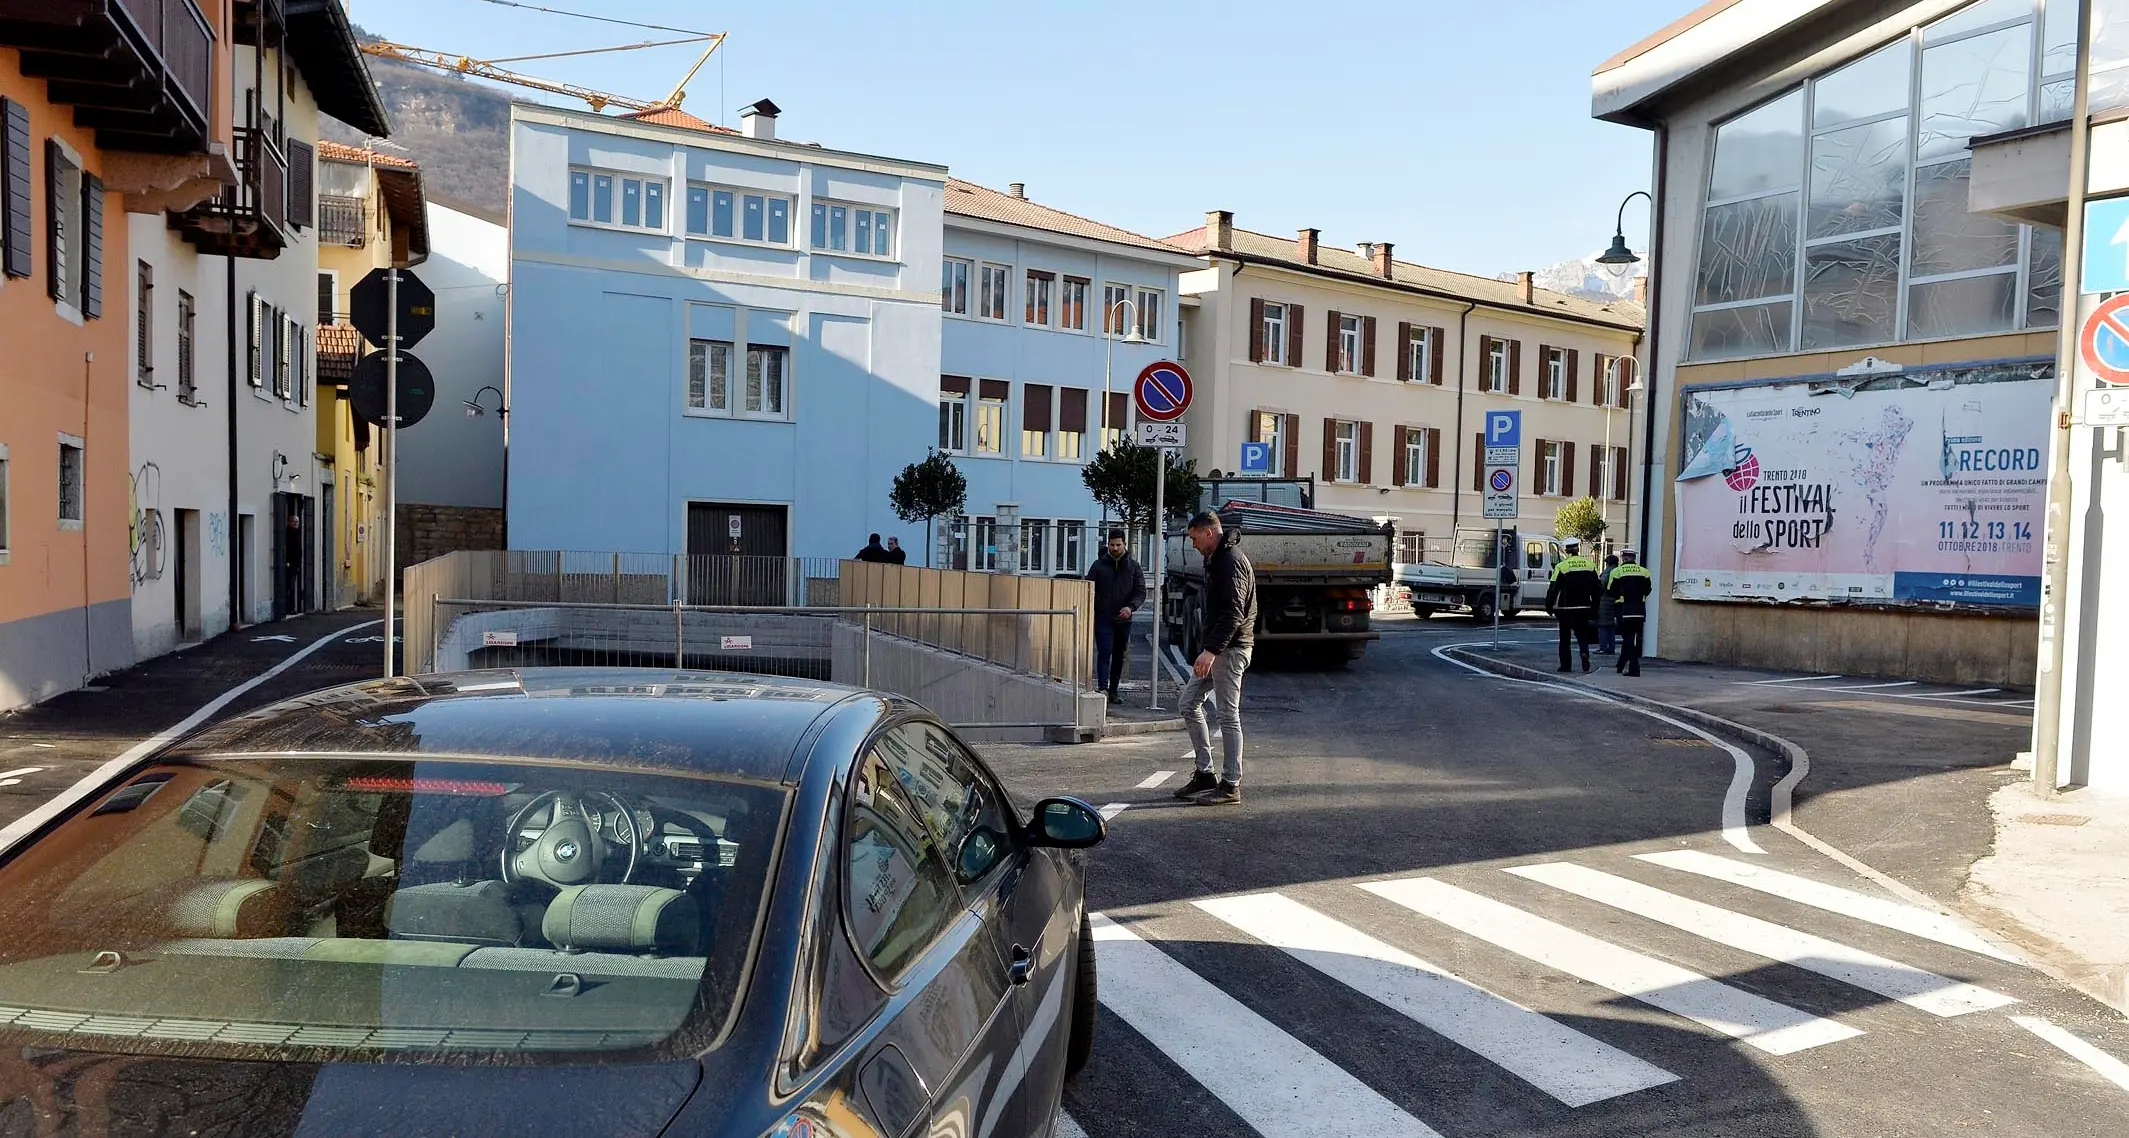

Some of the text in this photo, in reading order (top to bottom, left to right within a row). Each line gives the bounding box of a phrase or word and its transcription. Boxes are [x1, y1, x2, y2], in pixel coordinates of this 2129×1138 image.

[1792, 408, 1821, 418] TRENTINO
[1146, 425, 1153, 433] 0
[1166, 425, 1178, 433] 24
[1493, 415, 1512, 442] P
[1246, 446, 1262, 467] P
[1960, 448, 2040, 471] RECORD
[1763, 470, 1788, 481] TRENTO
[1739, 483, 1836, 513] il FESTIVAL
[1733, 519, 1823, 548] dello SPORT
[1939, 521, 2031, 540] 11 12 13 14
[1938, 541, 2032, 553] OTTOBRE 2018 TRENTO
